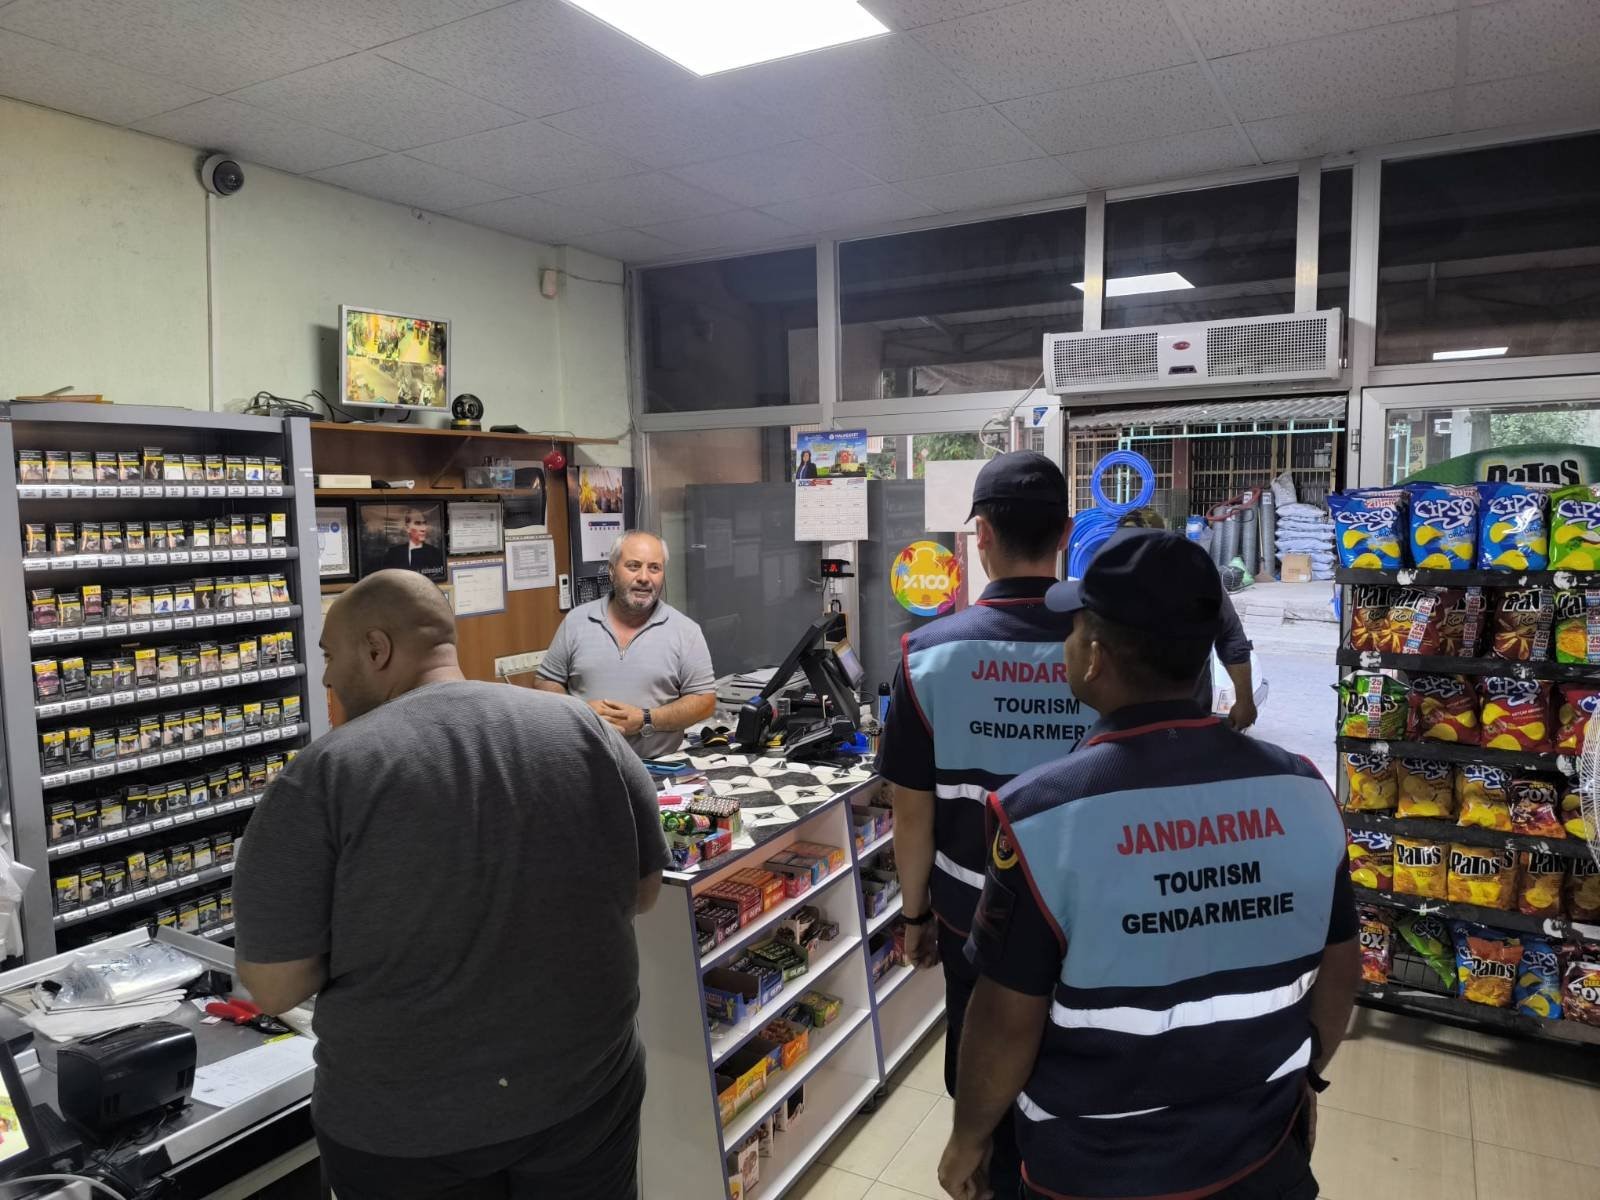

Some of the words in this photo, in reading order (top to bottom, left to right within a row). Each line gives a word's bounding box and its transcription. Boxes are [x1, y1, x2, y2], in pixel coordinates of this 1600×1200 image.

[971, 660, 1068, 683] JANDAR
[994, 697, 1080, 714] TOURISM
[969, 720, 1092, 740] GENDARMER
[1116, 807, 1286, 855] JANDARMA
[1153, 861, 1261, 896] TOURISM
[1121, 892, 1294, 934] GENDARMERIE
